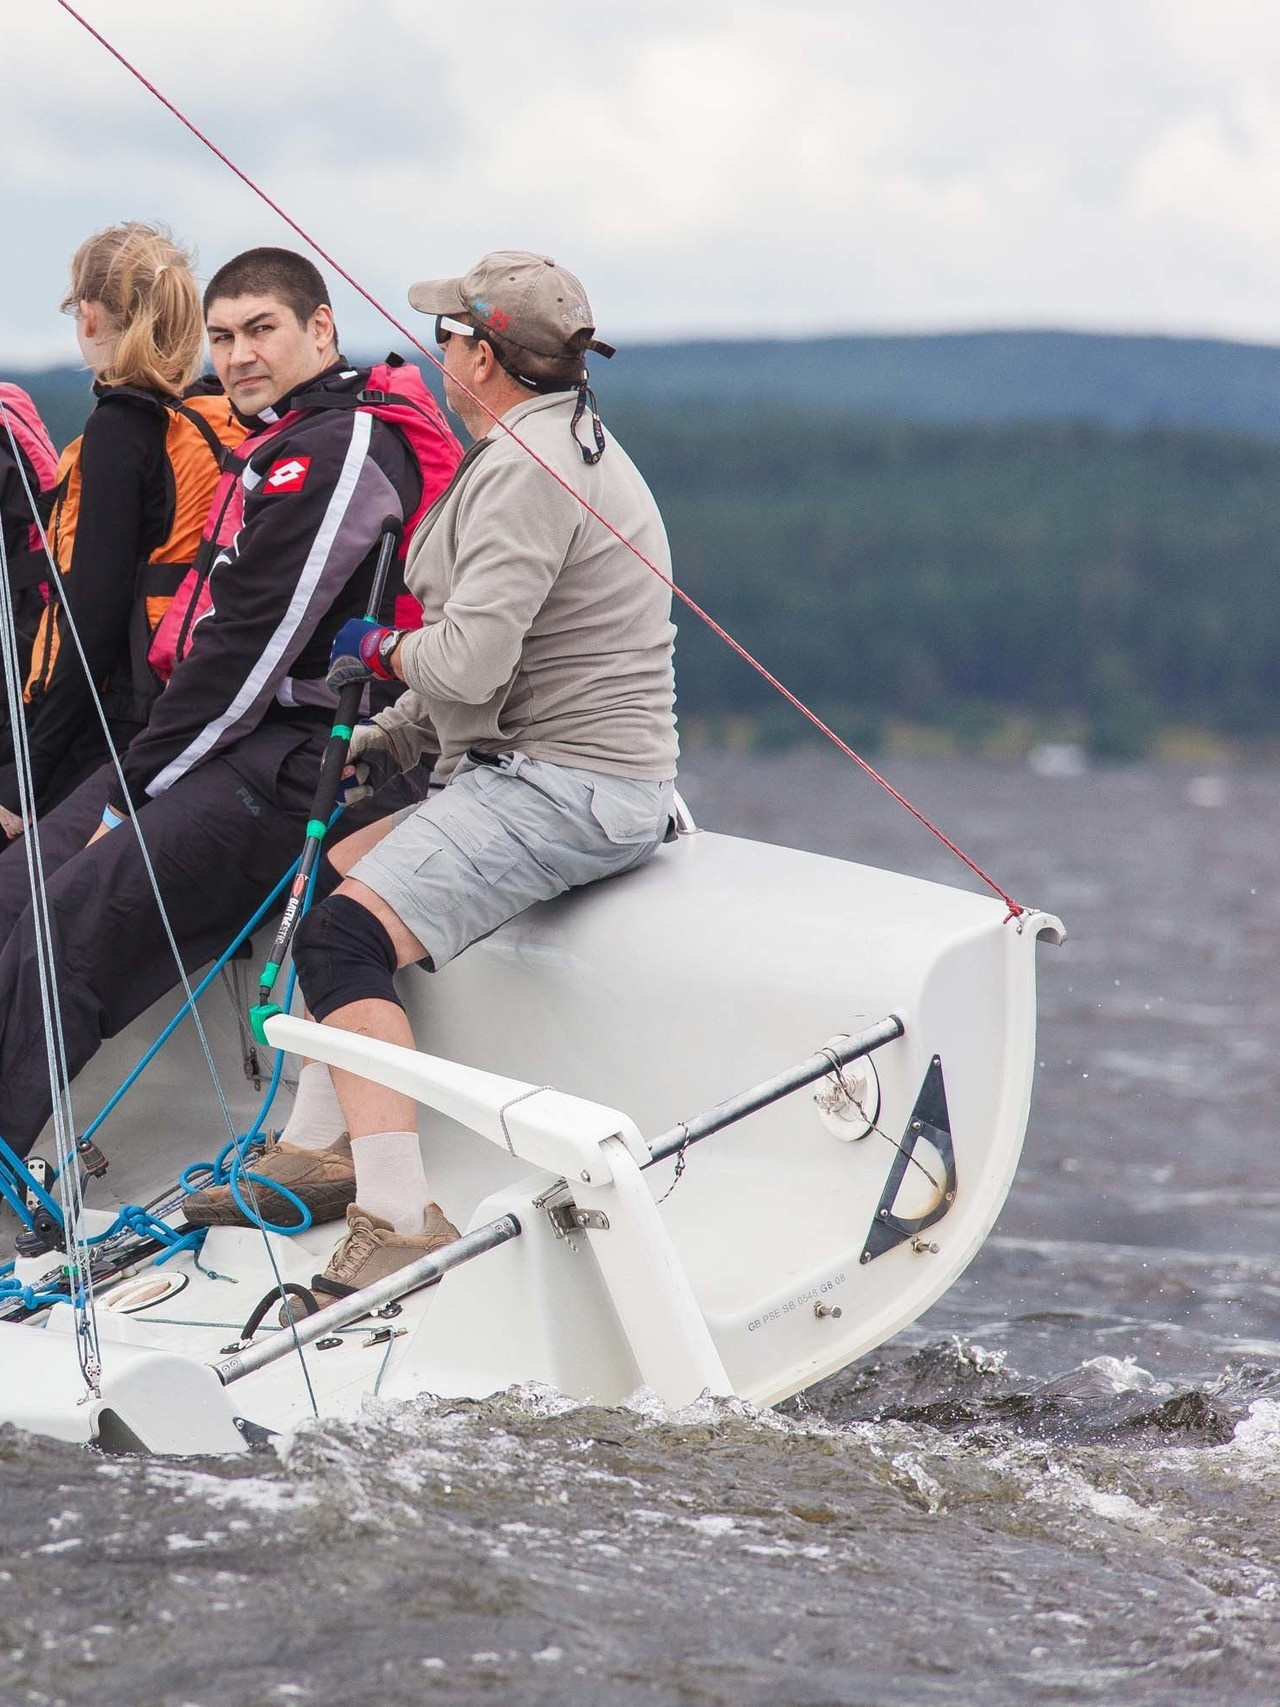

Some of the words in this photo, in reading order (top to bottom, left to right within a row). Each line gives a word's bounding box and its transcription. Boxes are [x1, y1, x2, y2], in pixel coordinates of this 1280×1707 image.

[236, 786, 261, 817] FILA
[762, 1309, 782, 1324] PSE
[783, 1301, 796, 1314] SB
